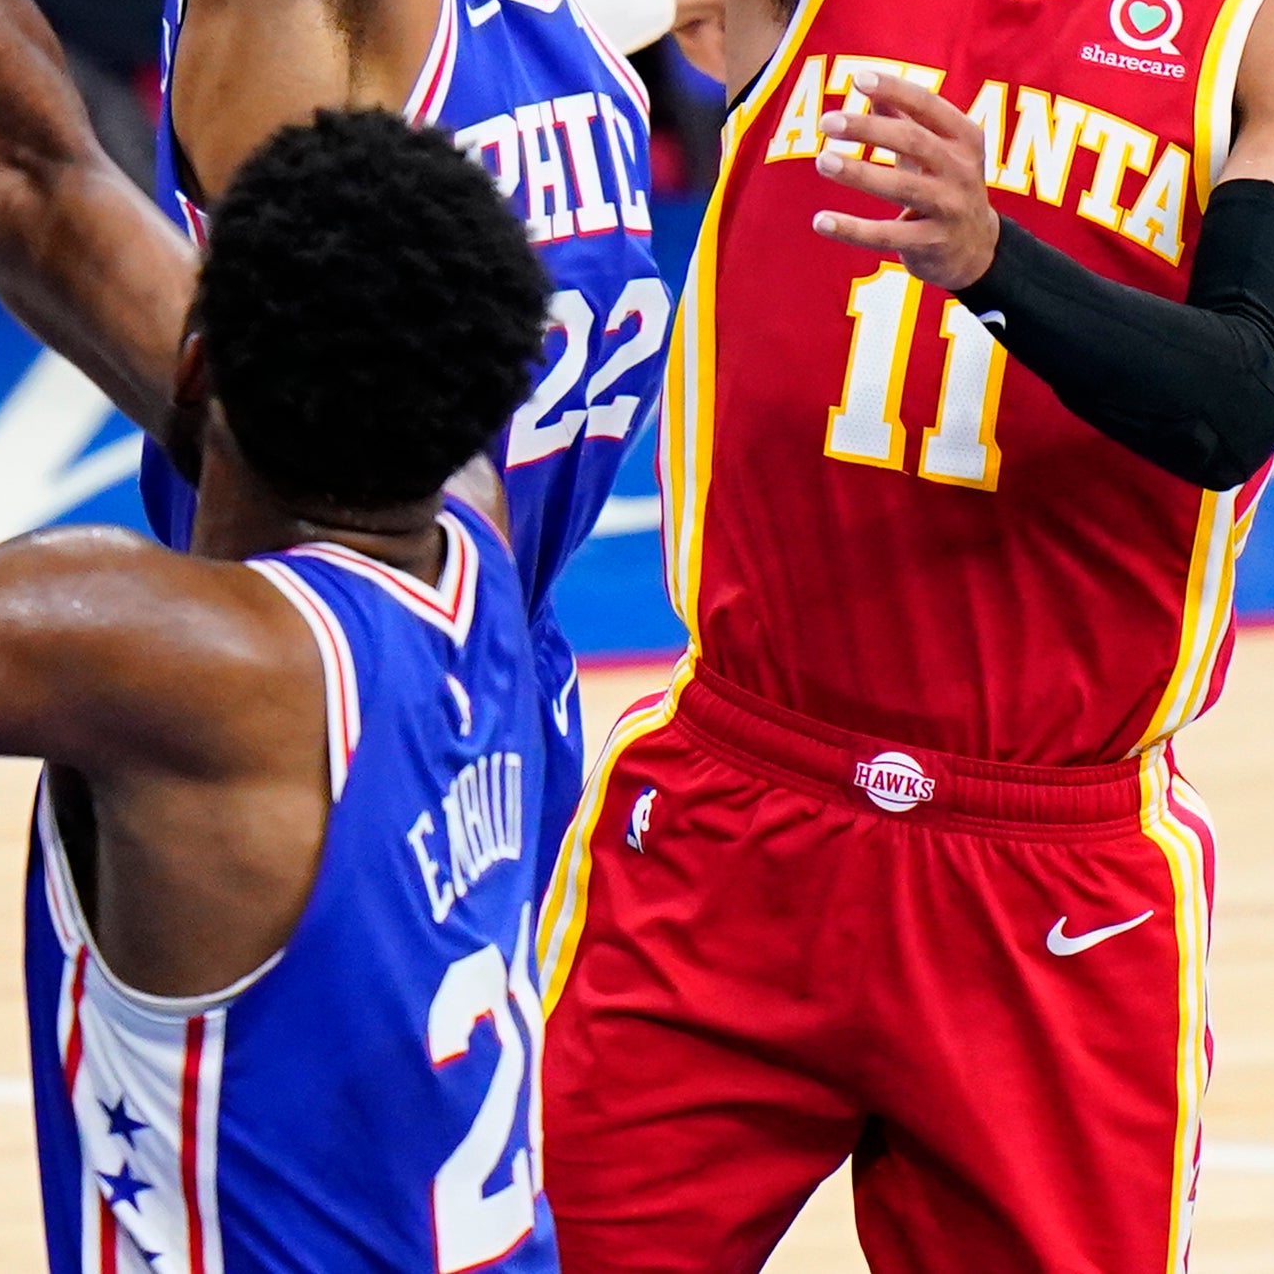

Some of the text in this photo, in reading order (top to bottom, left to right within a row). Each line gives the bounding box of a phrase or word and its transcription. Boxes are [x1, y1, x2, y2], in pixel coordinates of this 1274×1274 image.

[1081, 43, 1186, 79] sharecare
[504, 278, 672, 469] 22
[823, 260, 1008, 492] 11
[856, 765, 933, 801] HAWKS
